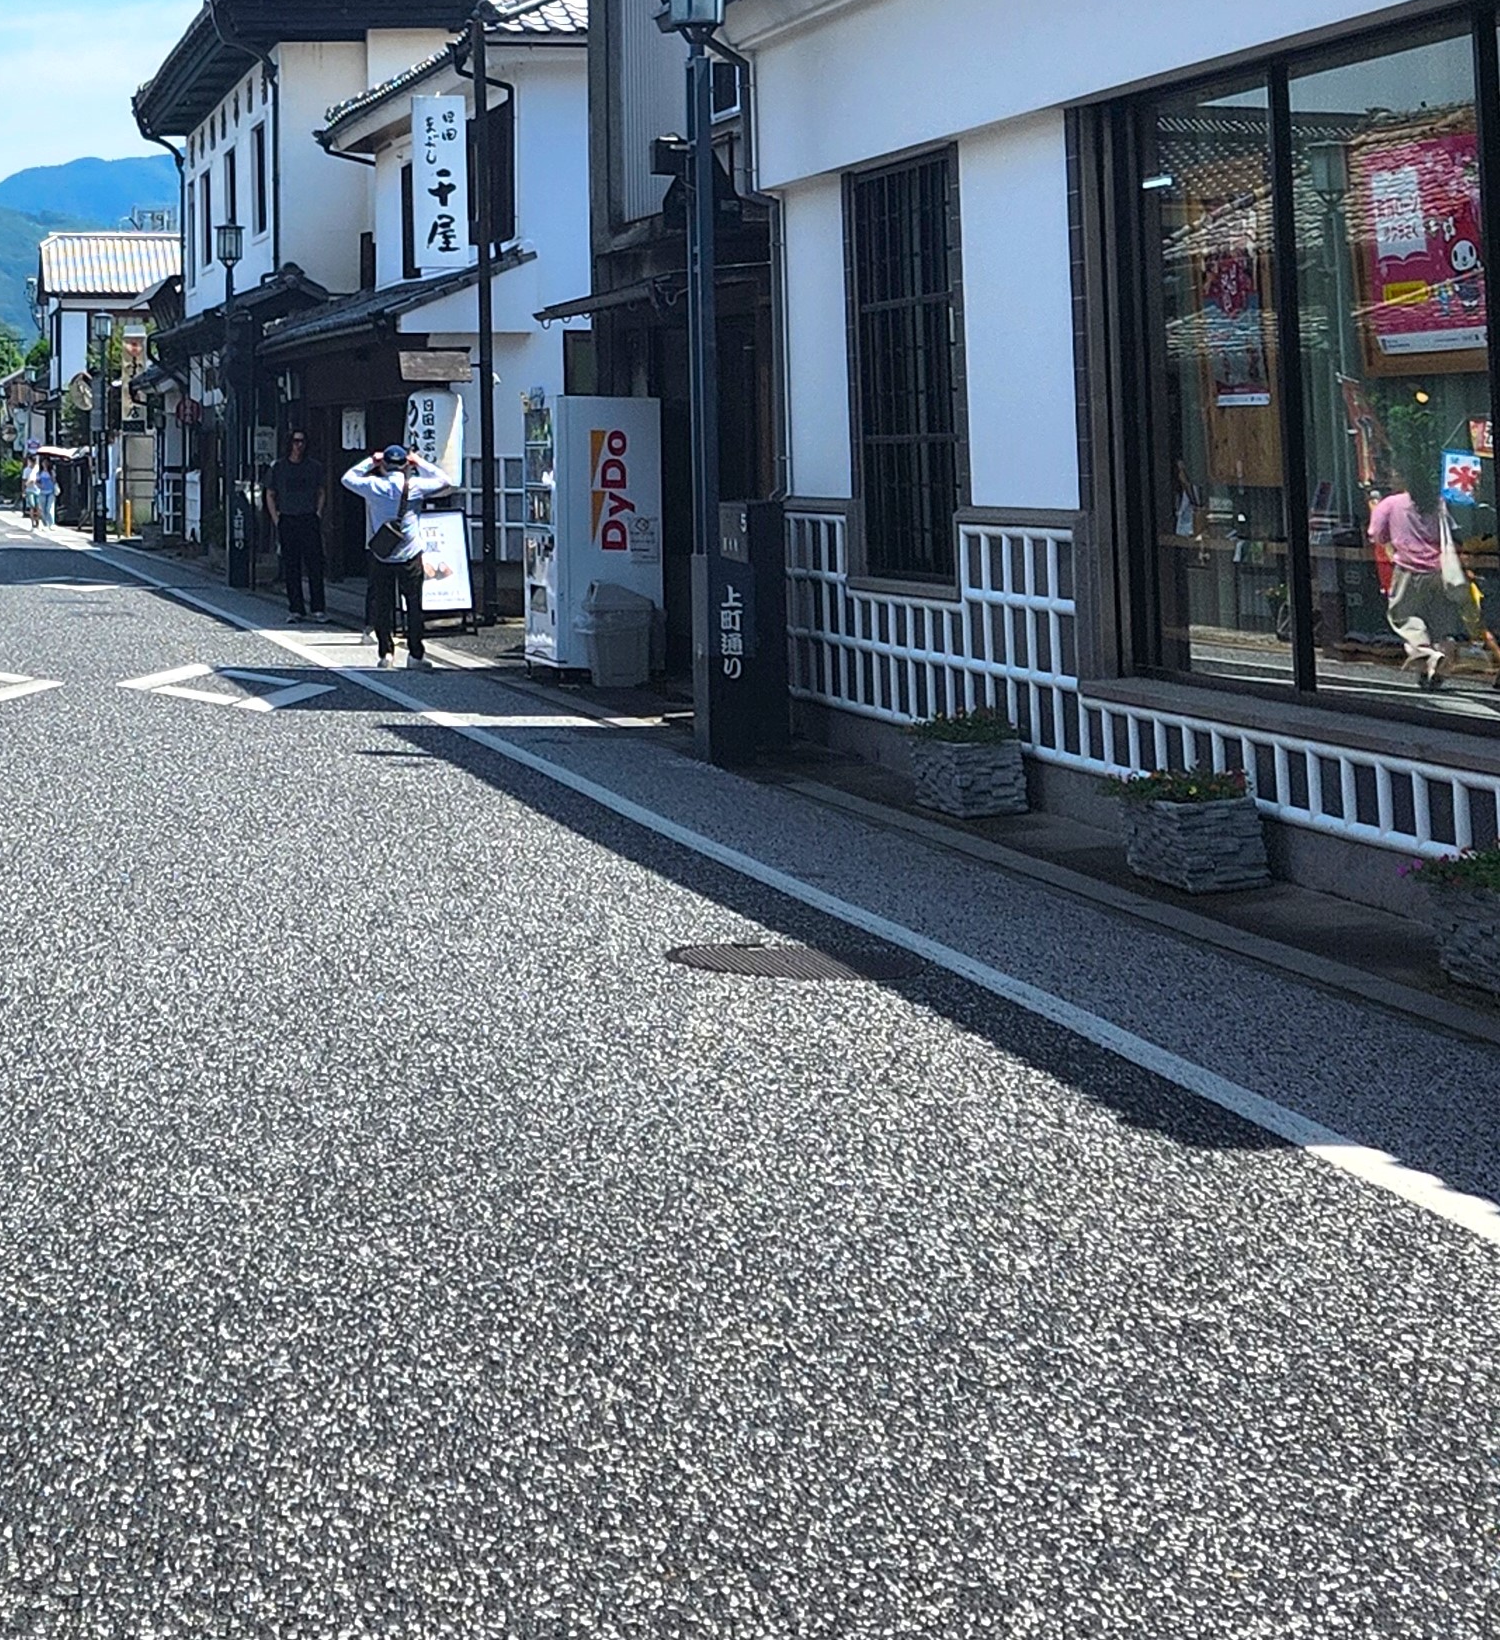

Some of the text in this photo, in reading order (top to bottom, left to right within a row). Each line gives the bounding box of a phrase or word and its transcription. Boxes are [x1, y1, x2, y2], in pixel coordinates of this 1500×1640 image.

[425, 116, 439, 164] まぶし
[442, 111, 457, 141] 日田
[427, 168, 461, 252] 千屋
[422, 399, 437, 463] 日田まぶし
[601, 430, 635, 550] DyDo
[720, 584, 743, 679] 上町通り
